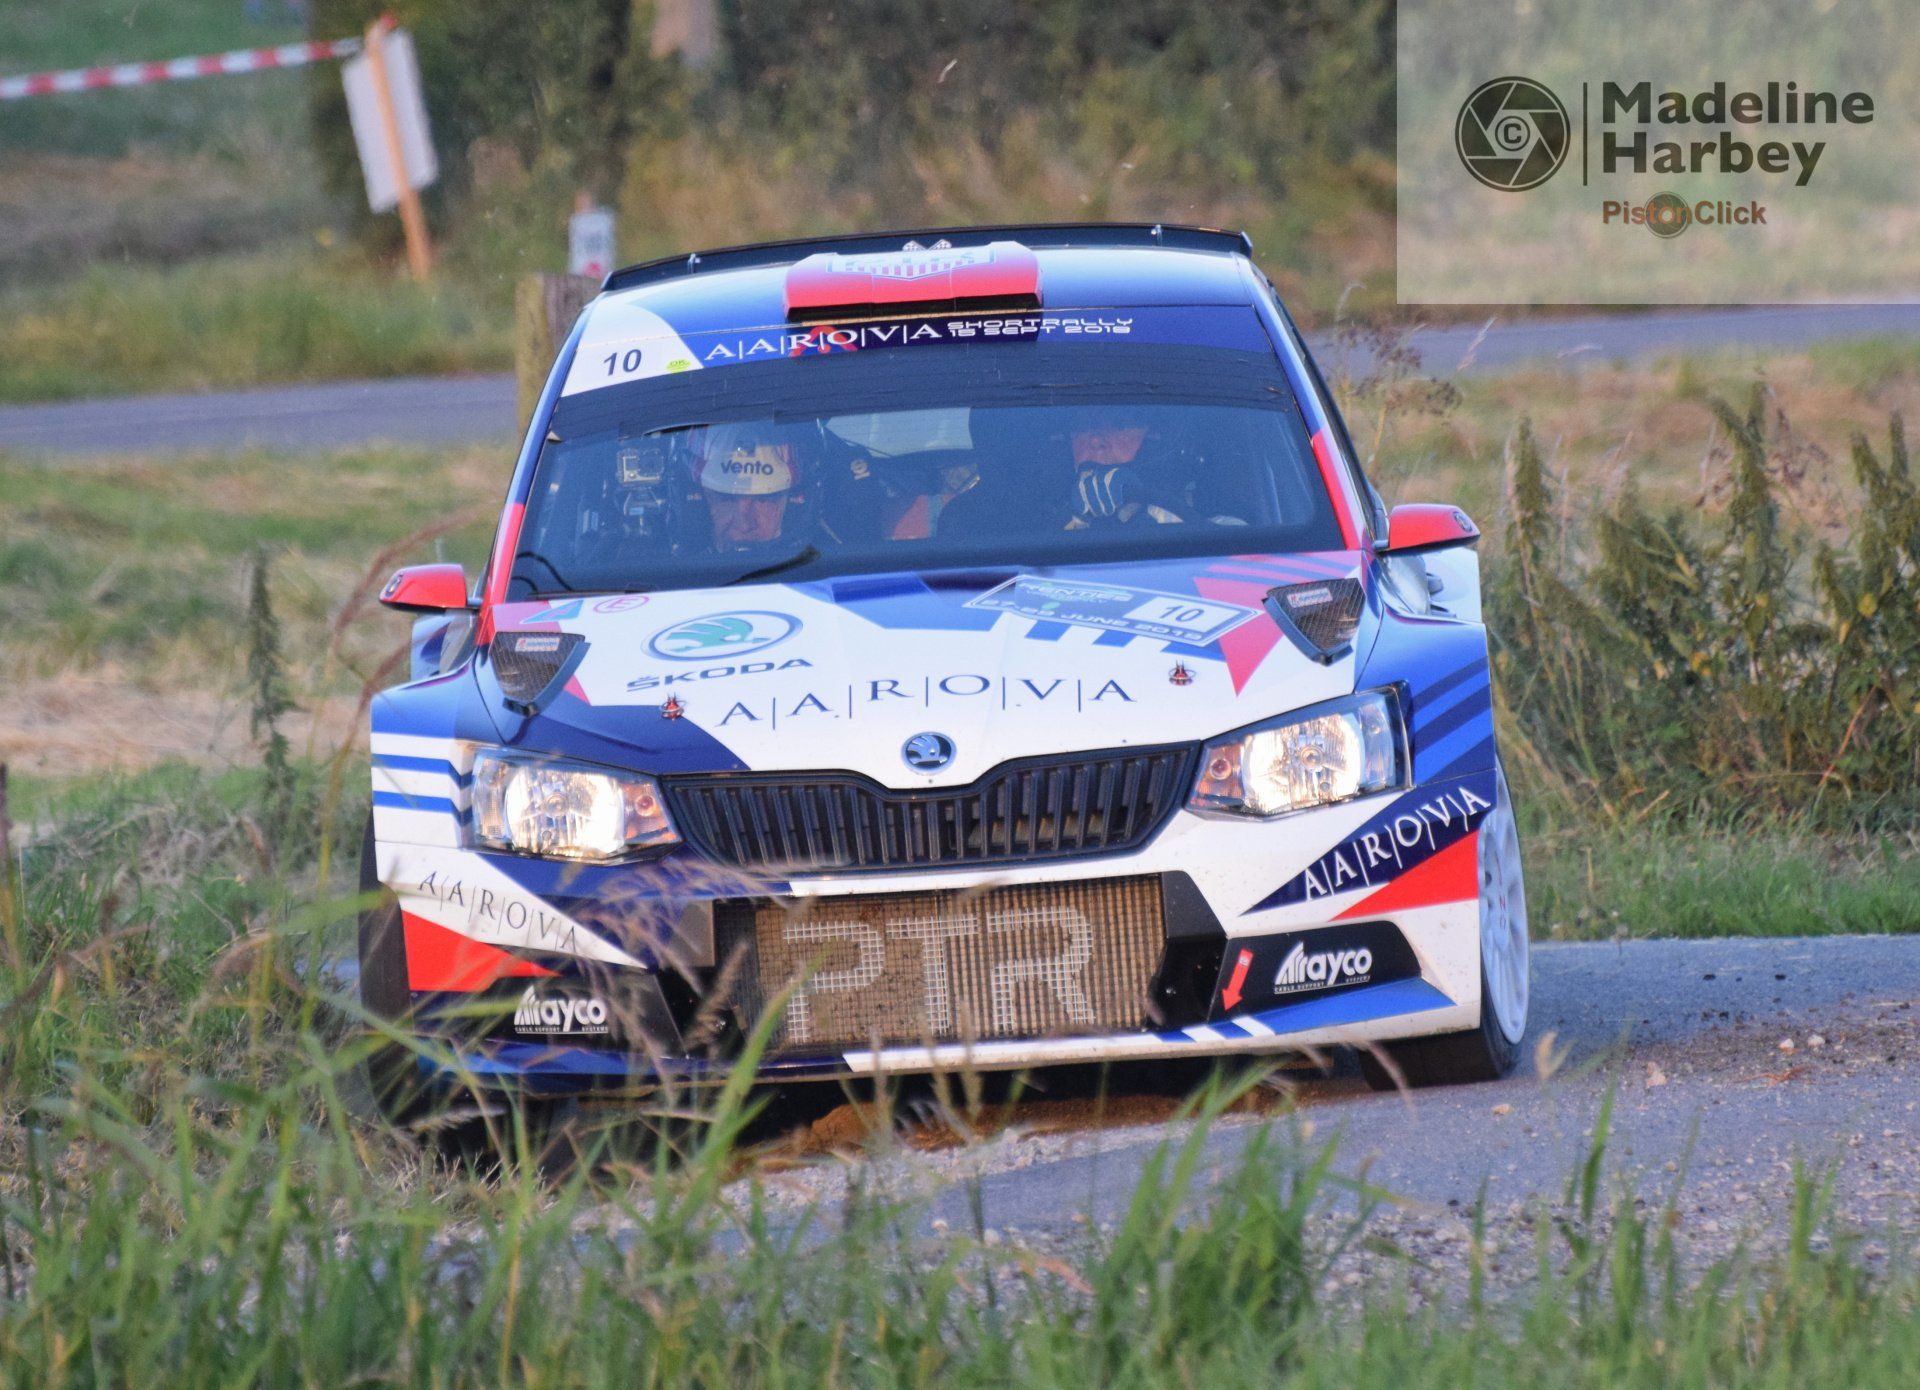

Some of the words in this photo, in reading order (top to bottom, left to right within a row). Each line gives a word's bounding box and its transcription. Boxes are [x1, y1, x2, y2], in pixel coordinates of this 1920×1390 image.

[947, 317, 1133, 330] SHORTRALLY
[984, 326, 1056, 336] SEPT
[603, 349, 642, 377] 10
[1158, 604, 1205, 623] 10
[783, 906, 1096, 1043] PTR
